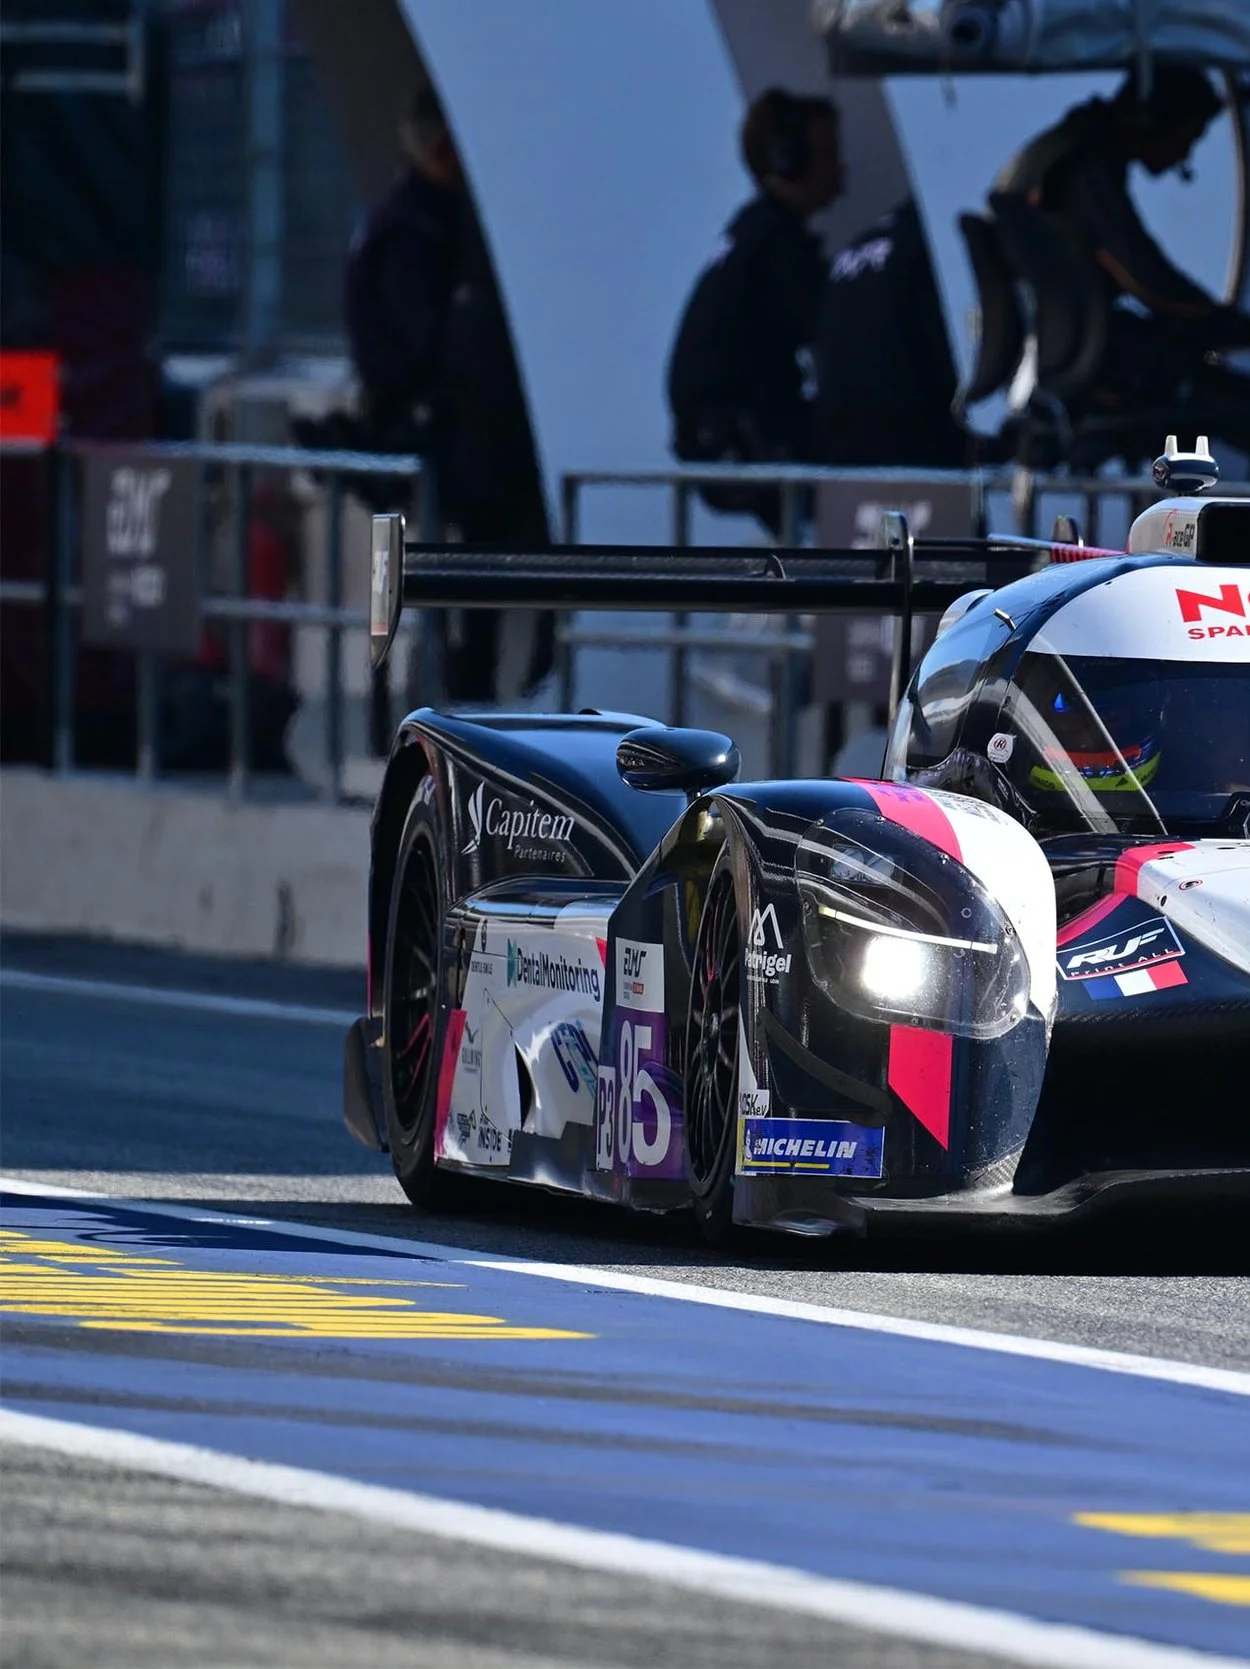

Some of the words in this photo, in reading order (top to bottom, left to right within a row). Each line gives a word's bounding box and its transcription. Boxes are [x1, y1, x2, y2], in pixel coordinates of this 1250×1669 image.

[486, 798, 575, 850] Capitem
[513, 844, 567, 862] Partenaires
[1066, 927, 1166, 969] RUF
[516, 947, 602, 1003] DentalMonitoring
[618, 1019, 672, 1167] 85
[753, 1138, 858, 1159] MICHELIN
